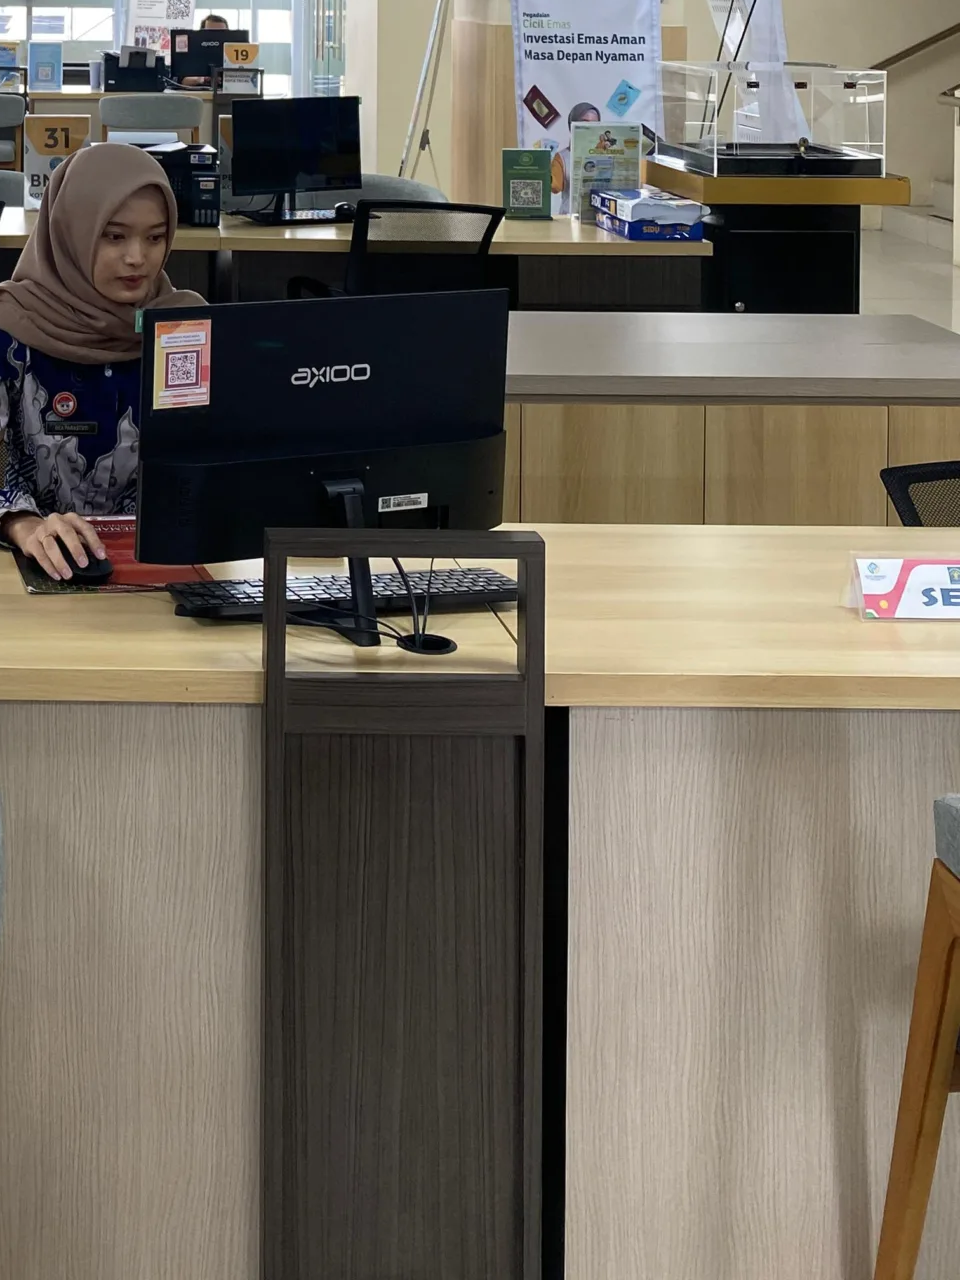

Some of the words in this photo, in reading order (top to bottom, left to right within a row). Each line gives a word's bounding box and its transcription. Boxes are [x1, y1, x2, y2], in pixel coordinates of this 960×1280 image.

[522, 19, 545, 29] Cicil
[546, 19, 572, 29] Emas
[523, 33, 575, 44] Investasi
[577, 33, 609, 45] Emas
[610, 33, 646, 45] Aman
[233, 49, 249, 61] 19
[524, 49, 554, 60] Masa
[556, 50, 593, 63] Depan
[595, 50, 645, 64] Nyaman
[44, 127, 70, 149] 31
